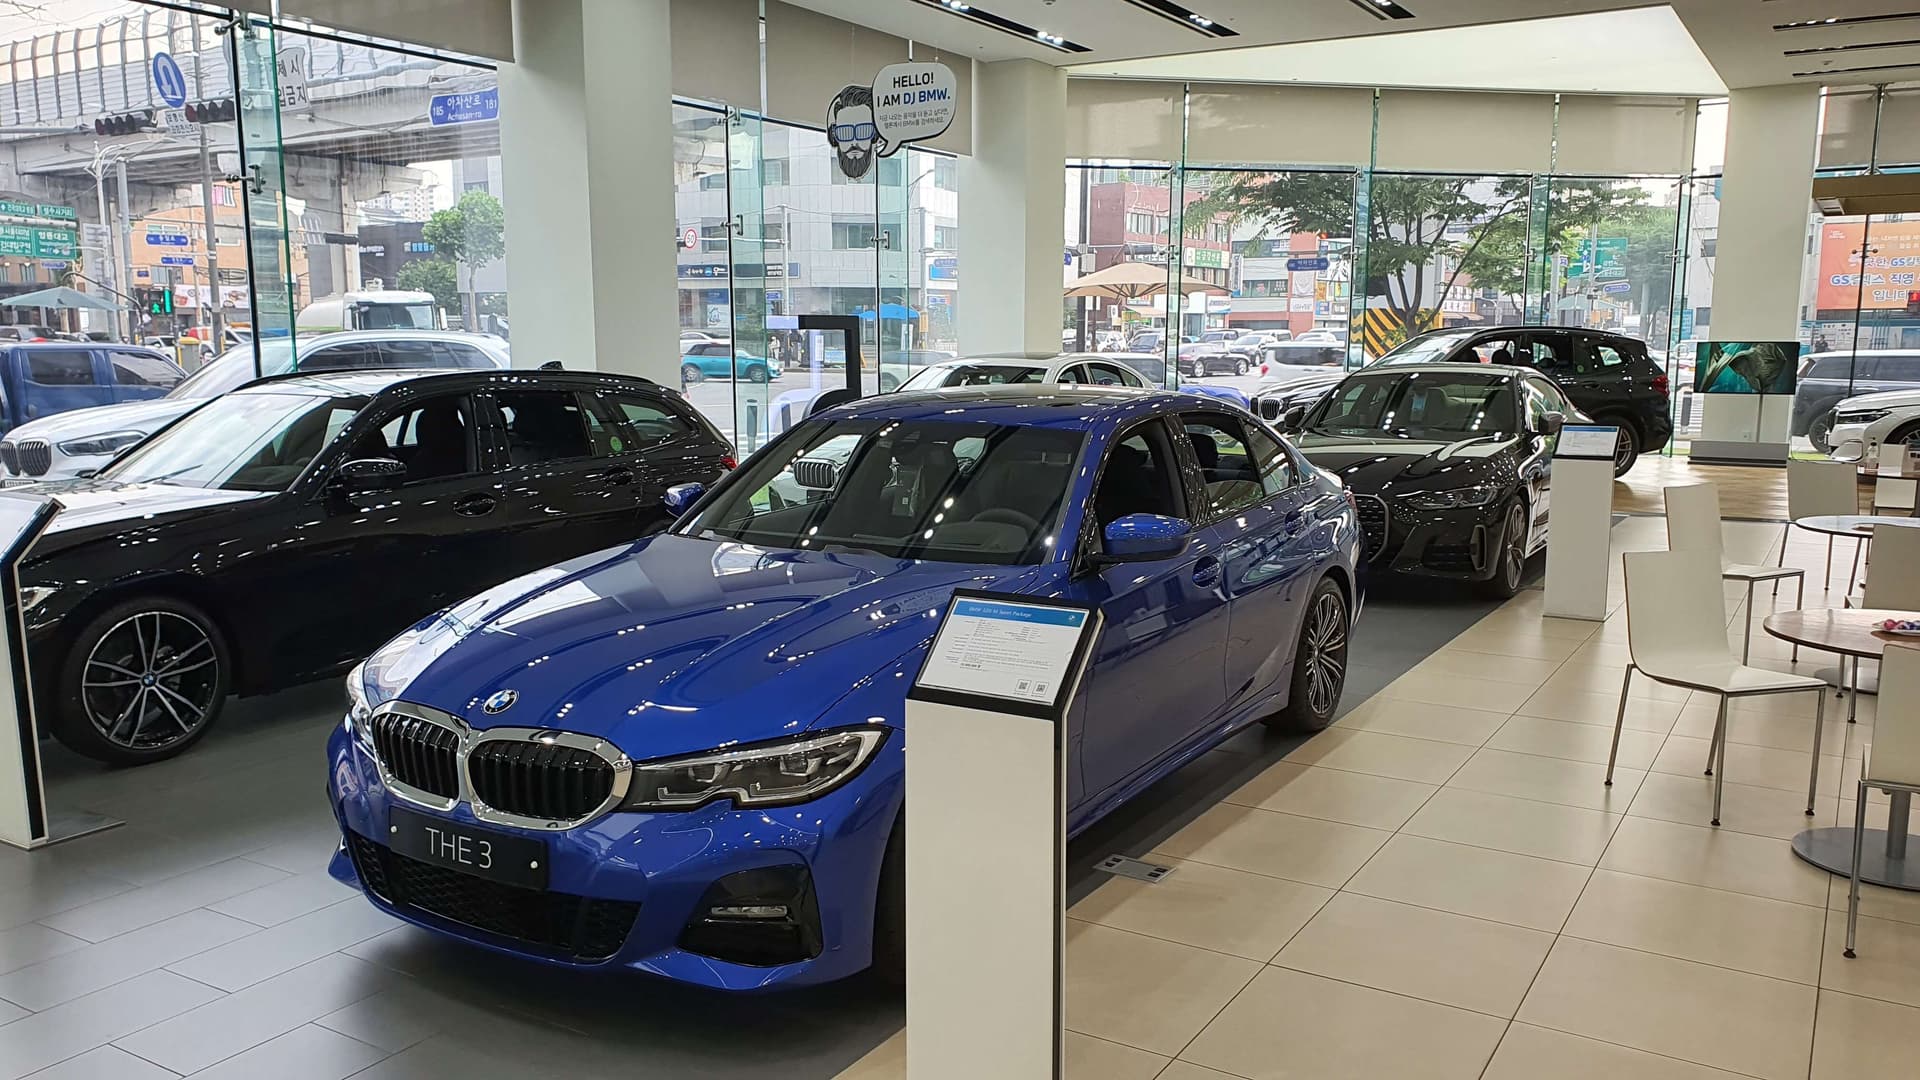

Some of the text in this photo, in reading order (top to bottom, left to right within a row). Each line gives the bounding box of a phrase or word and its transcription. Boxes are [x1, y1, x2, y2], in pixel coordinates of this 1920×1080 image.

[893, 72, 934, 89] HELLO!
[447, 95, 481, 110] 아차산로
[883, 94, 901, 107] AM
[903, 91, 916, 105] DJ
[918, 88, 951, 103] BMW.
[38, 231, 69, 241] 영동대교
[1890, 273, 1914, 286] 직영
[1012, 610, 1032, 618] Package
[425, 827, 492, 869] THE 3
